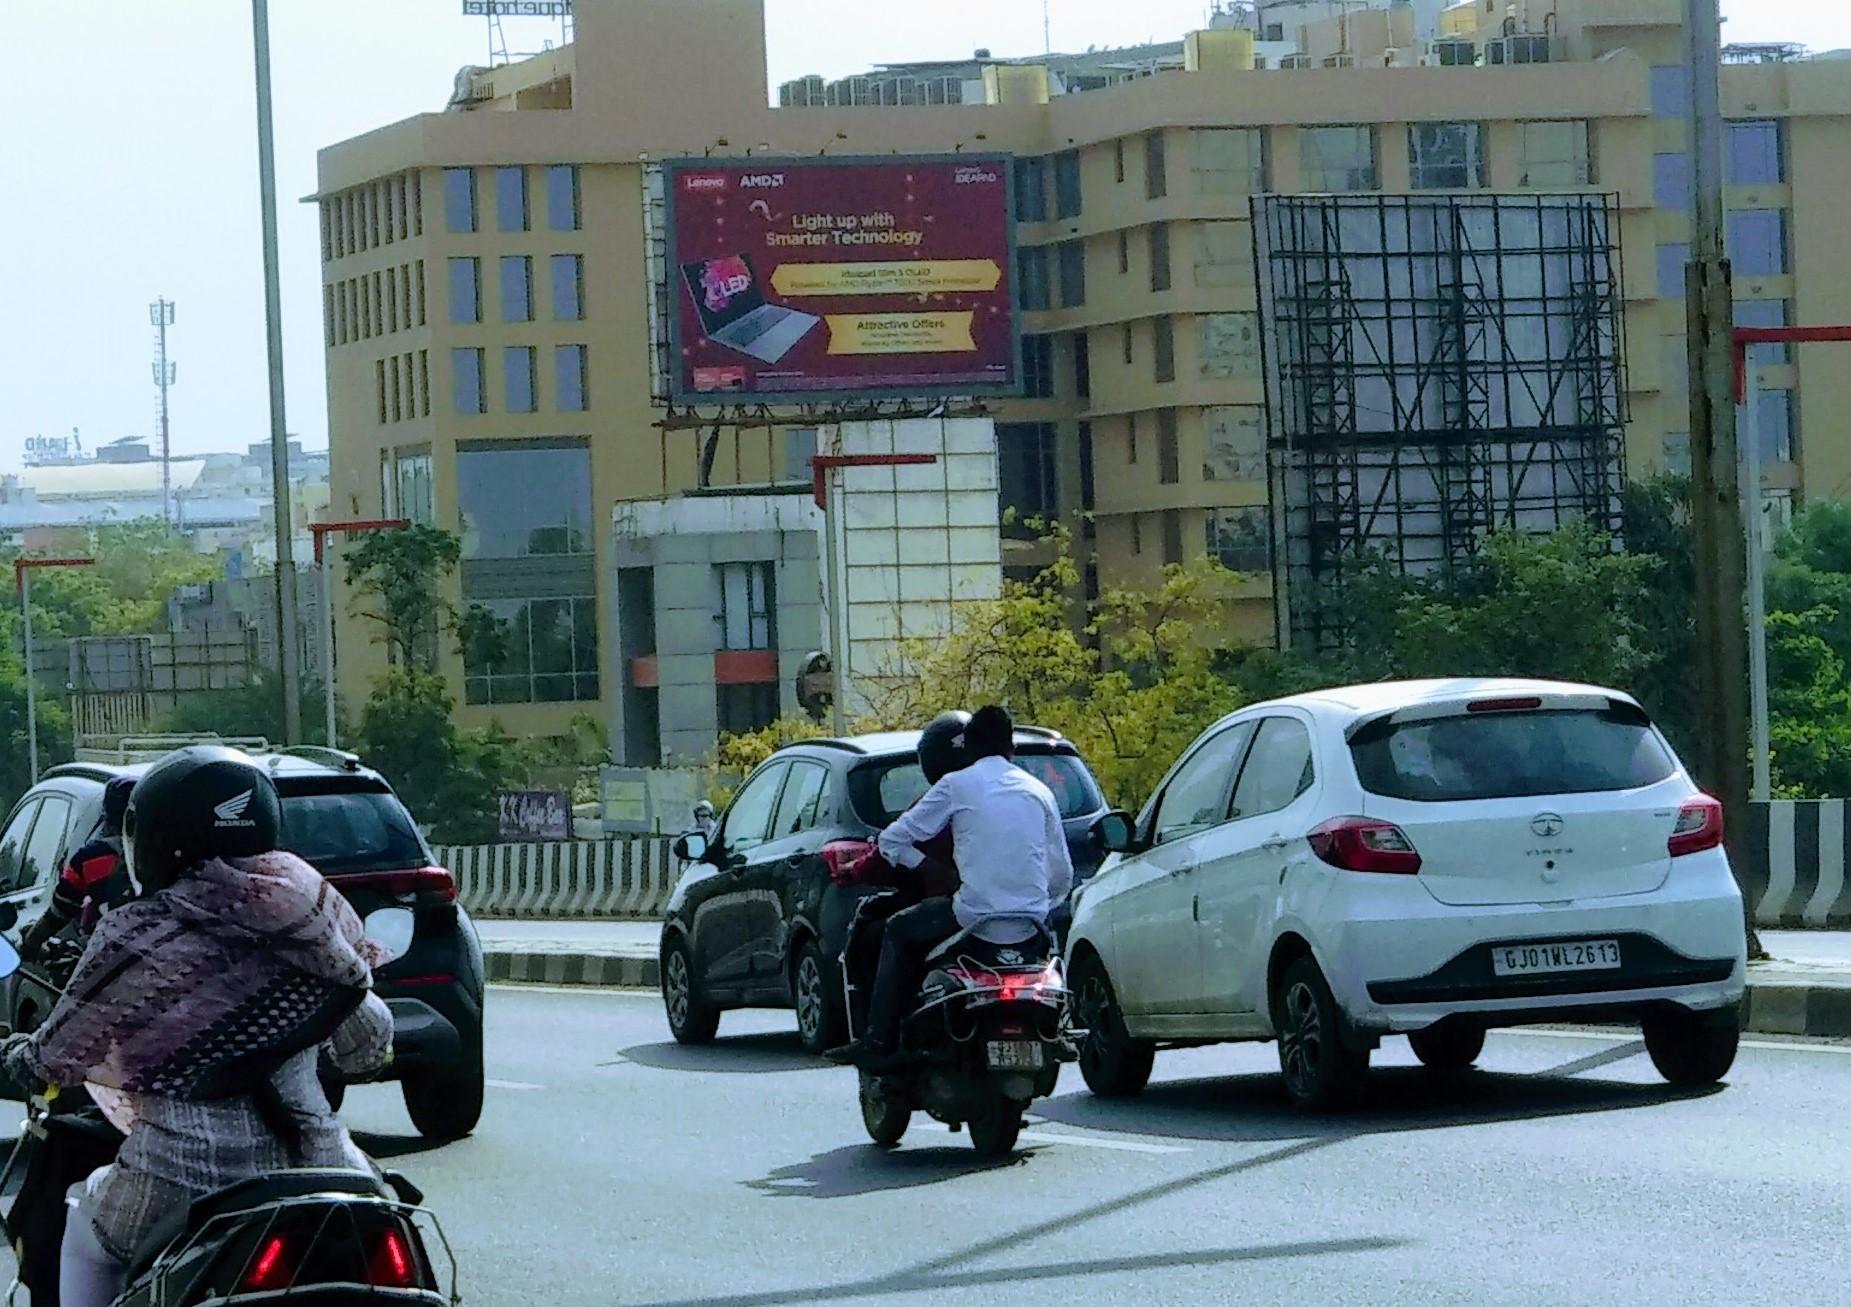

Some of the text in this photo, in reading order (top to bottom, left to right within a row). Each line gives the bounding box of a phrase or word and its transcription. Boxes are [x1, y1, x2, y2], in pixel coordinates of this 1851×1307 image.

[687, 177, 725, 188] Lenovo
[740, 175, 772, 187] AMD
[792, 211, 895, 230] Light up with
[766, 229, 923, 246] Smarter Technology
[857, 319, 945, 330] Attractive Offers
[214, 819, 256, 827] HONDA
